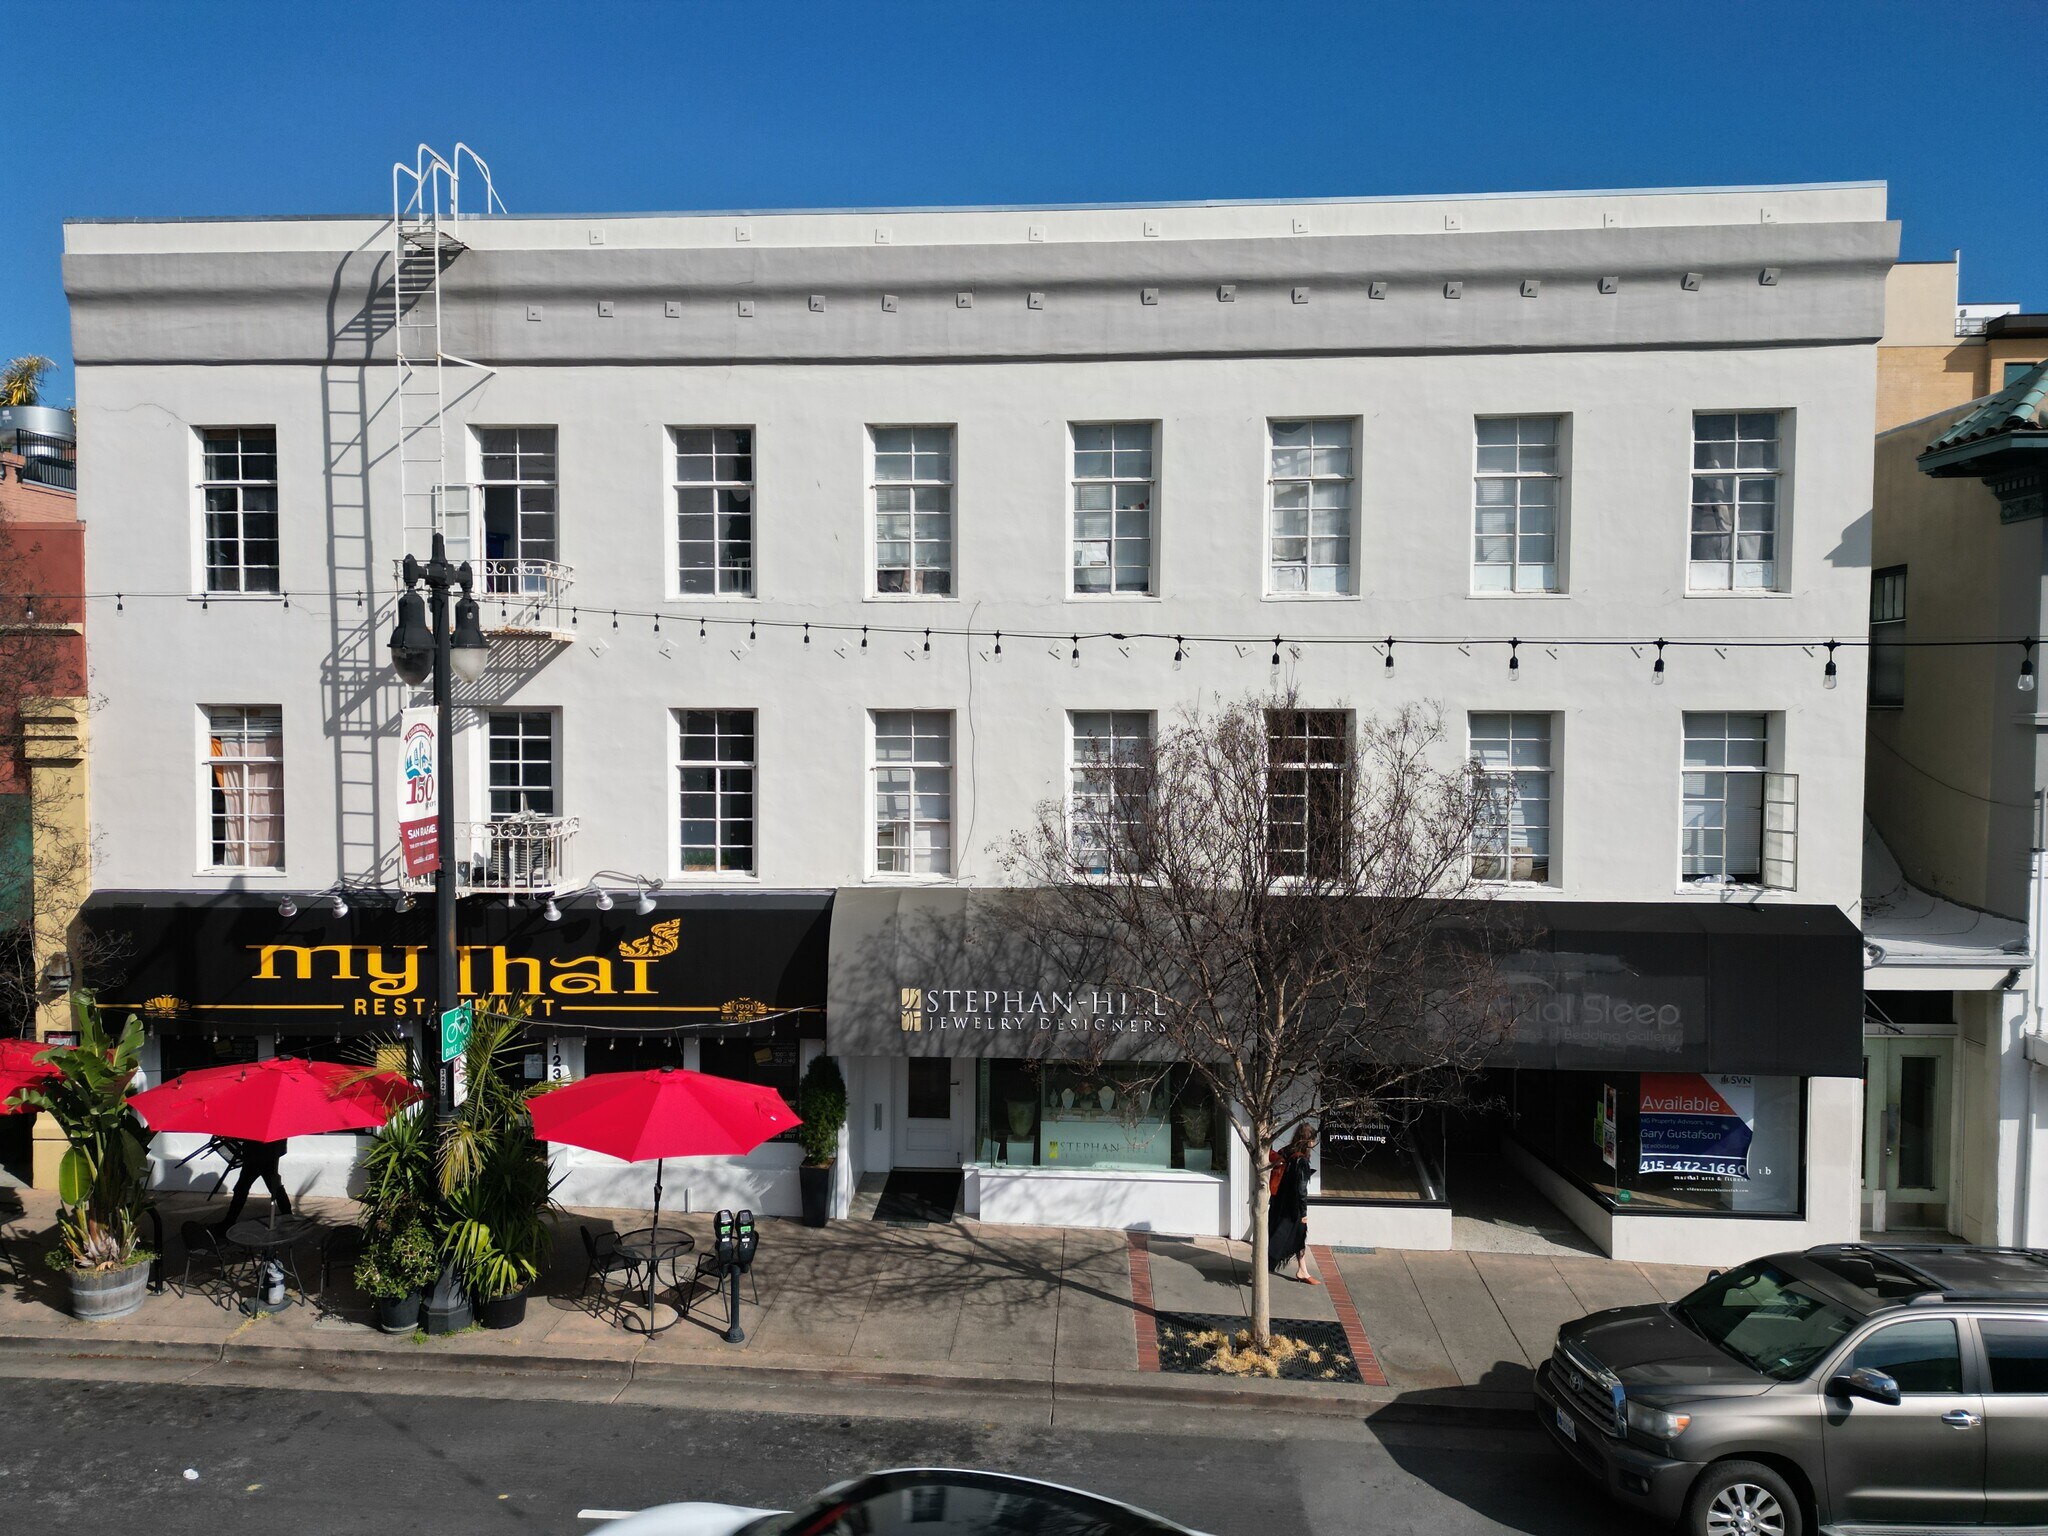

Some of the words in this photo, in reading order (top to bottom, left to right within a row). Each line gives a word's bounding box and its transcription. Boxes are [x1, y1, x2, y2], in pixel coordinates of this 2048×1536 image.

[406, 774, 434, 804] 150
[408, 829, 420, 839] SAN
[246, 944, 428, 995] my
[354, 998, 555, 1017] RESTRANT
[735, 1003, 755, 1011] 1991
[1583, 995, 1680, 1030] Sleep
[928, 1016, 1026, 1033] JEWELRY
[1040, 1018, 1168, 1034] DESIGNERS
[1564, 1029, 1622, 1044] Bedding
[1625, 1031, 1677, 1045] Gallery
[445, 1044, 458, 1058] BIKE
[1730, 1075, 1752, 1085] SVN
[1641, 1095, 1720, 1113] Available
[1651, 1118, 1676, 1126] Property
[1329, 1133, 1355, 1142] private
[1356, 1135, 1387, 1144] training
[1640, 1129, 1665, 1140] Gary
[1667, 1129, 1722, 1140] Gustafson
[1640, 1159, 1747, 1176] 415-472-1660
